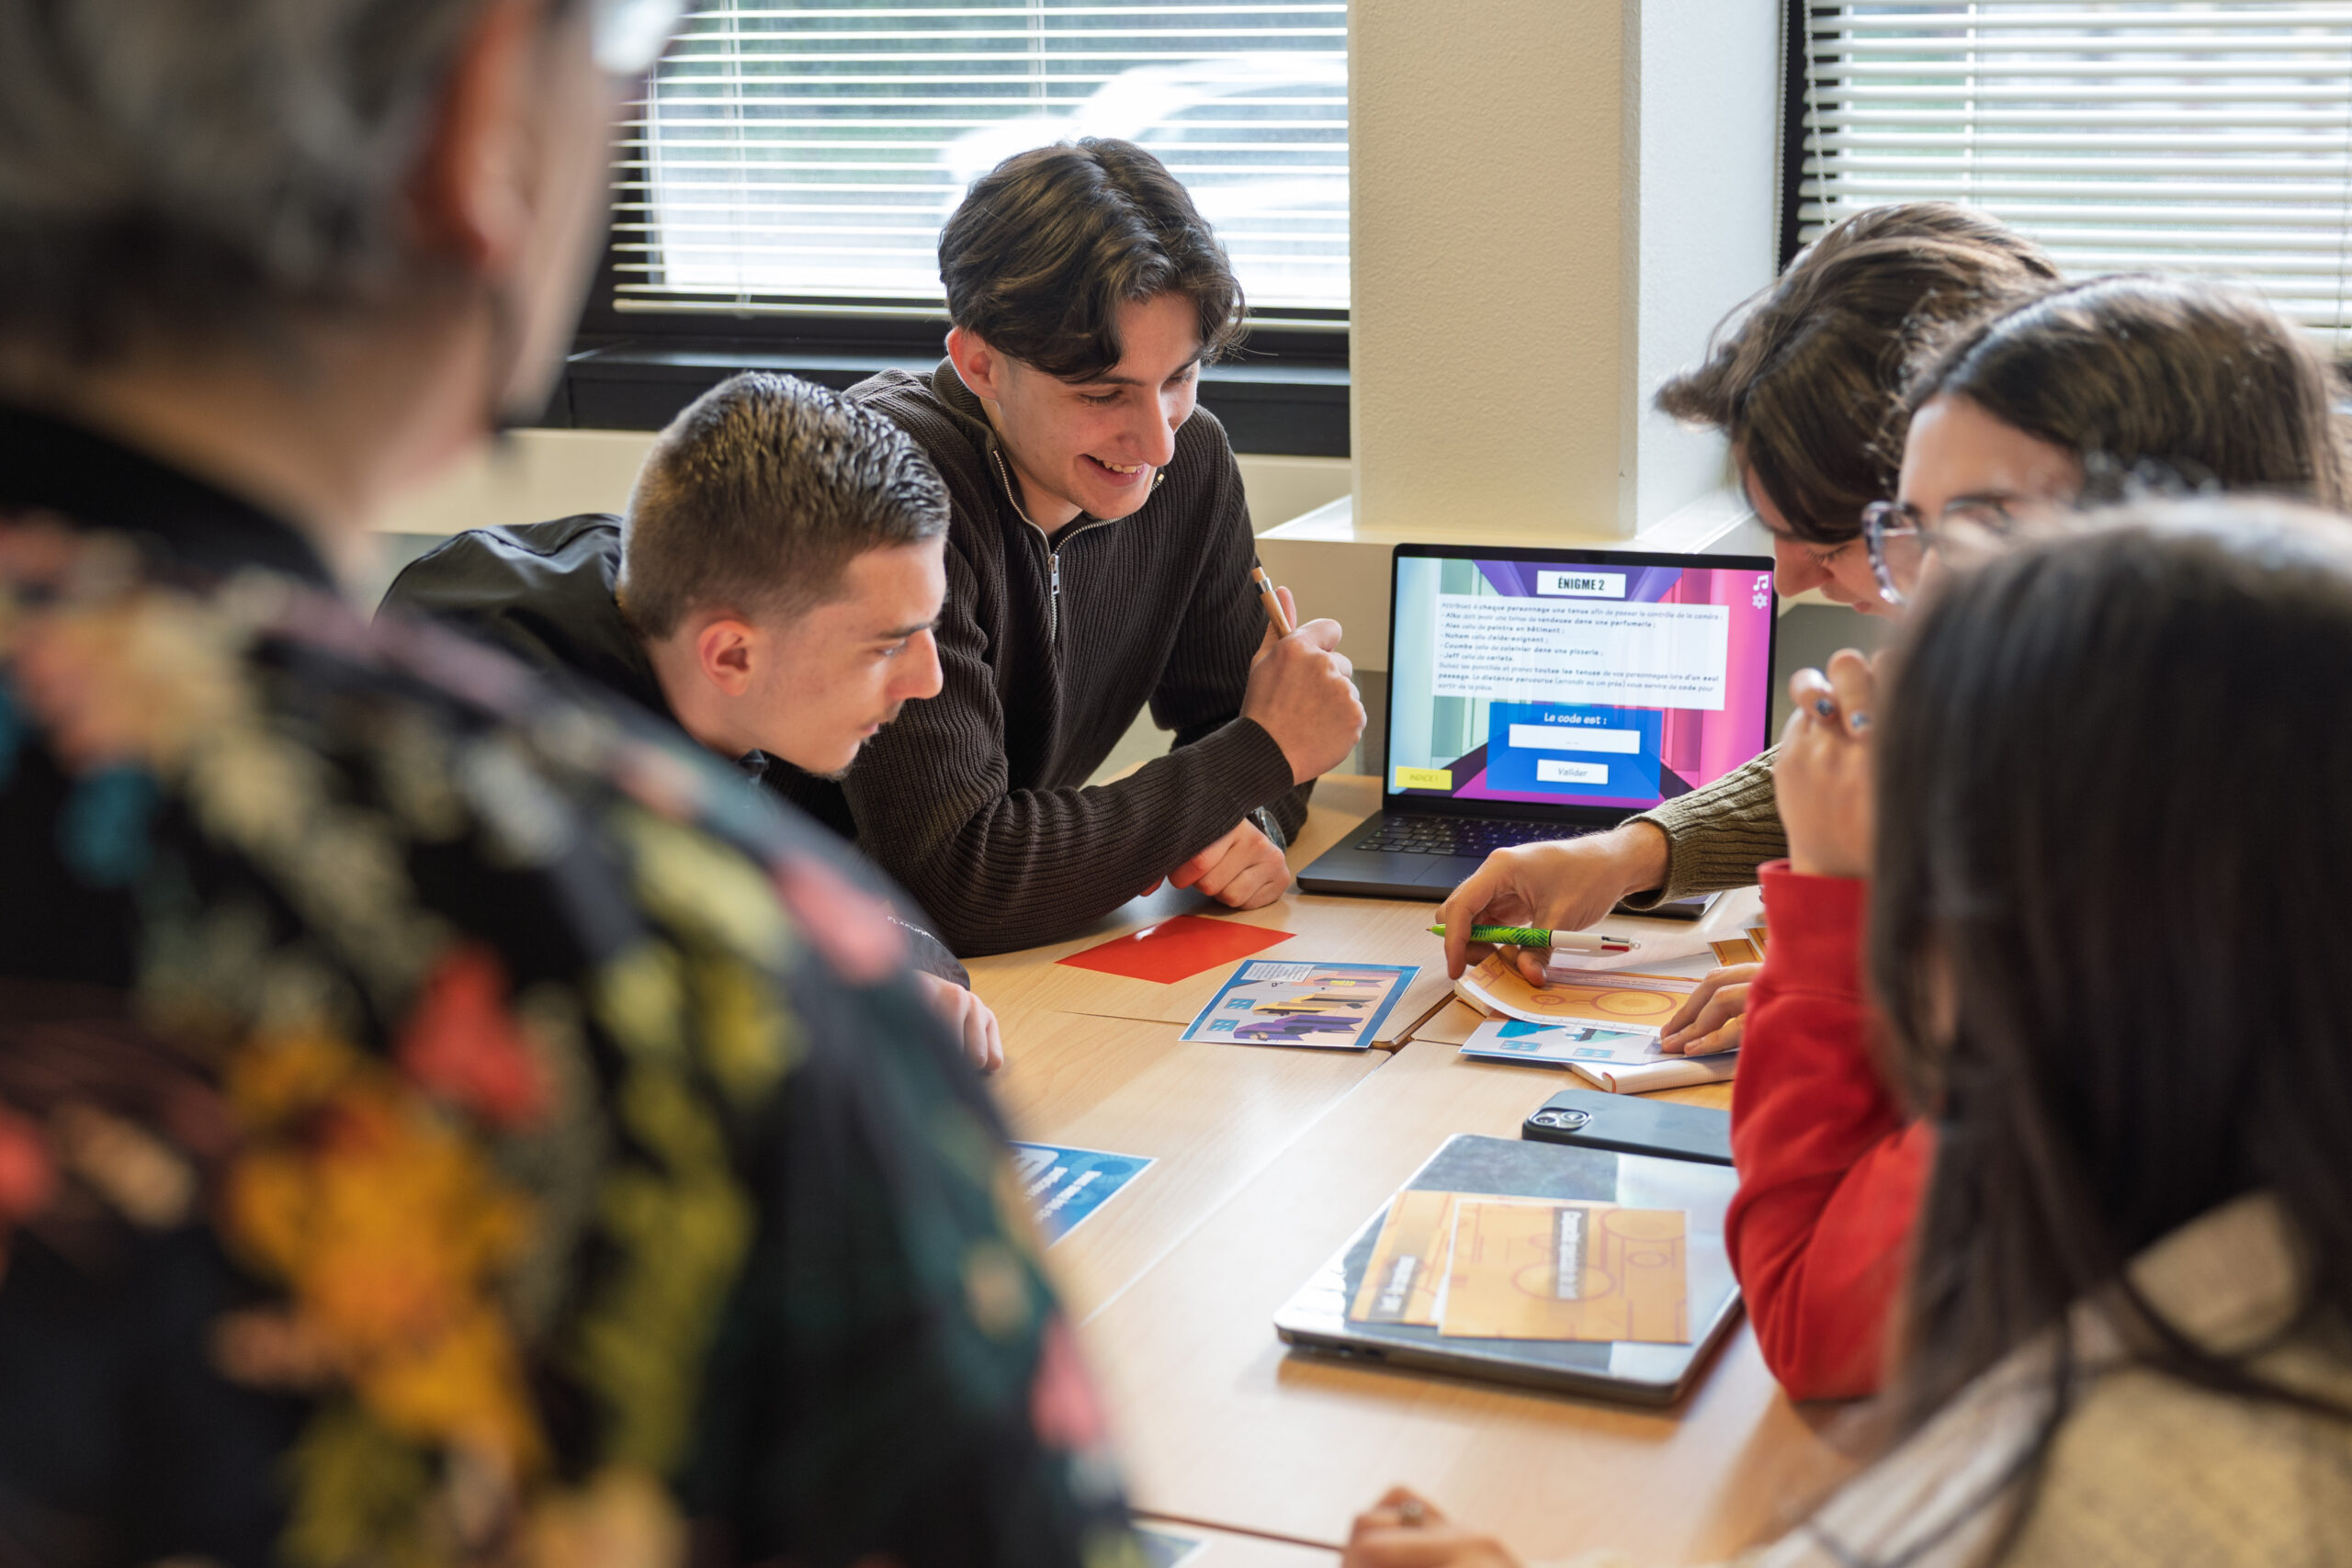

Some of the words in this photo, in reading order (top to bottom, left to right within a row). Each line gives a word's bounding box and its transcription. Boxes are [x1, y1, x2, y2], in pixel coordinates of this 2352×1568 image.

[1557, 576, 1596, 590] ÉNIGME
[1599, 580, 1605, 591] 2
[1544, 712, 1555, 722] Le
[1557, 714, 1581, 724] code
[1583, 716, 1601, 725] est
[1558, 768, 1588, 777] Valider
